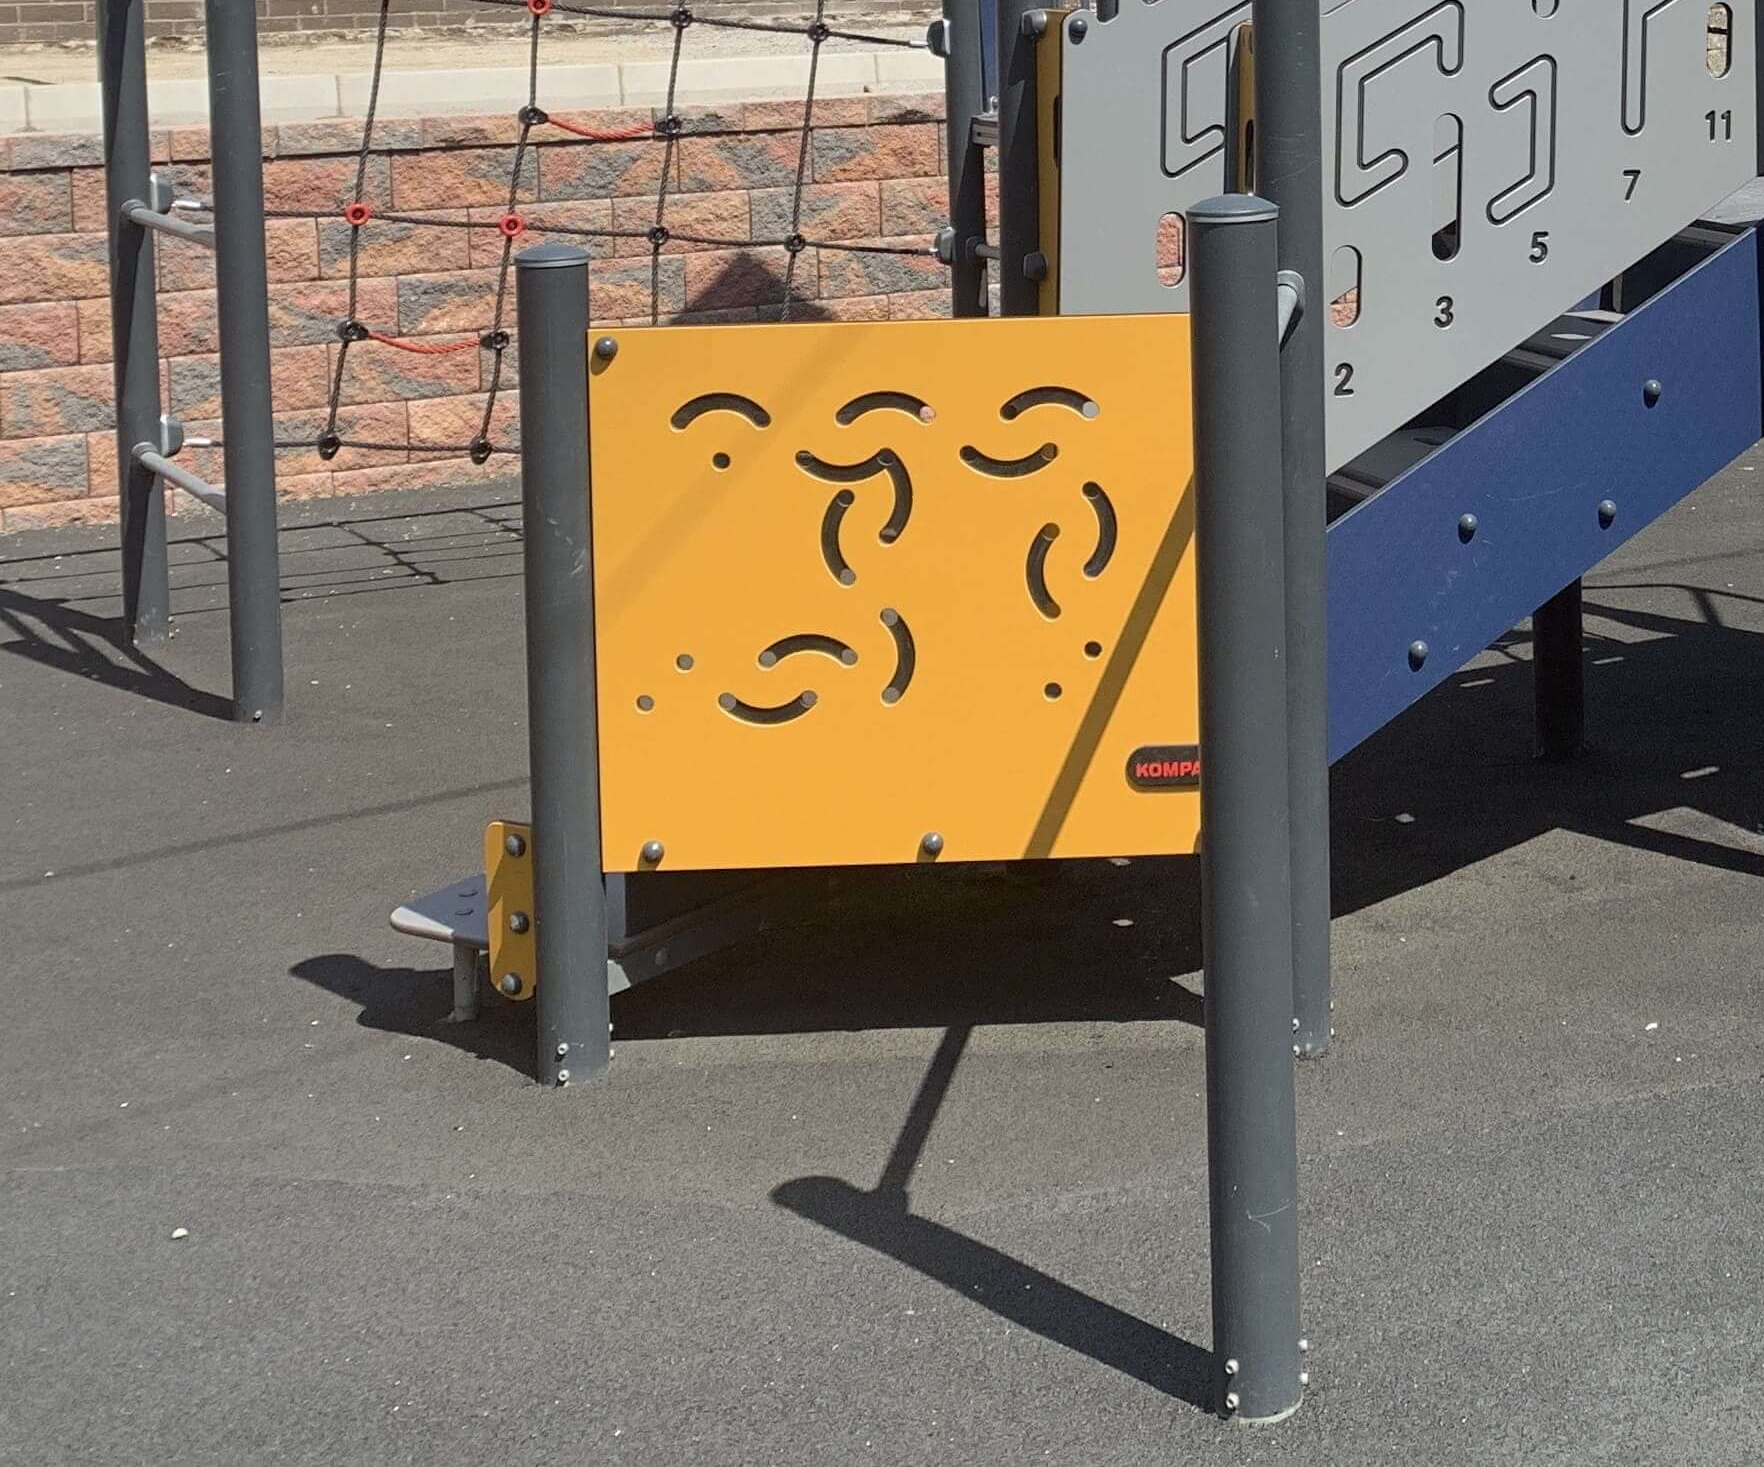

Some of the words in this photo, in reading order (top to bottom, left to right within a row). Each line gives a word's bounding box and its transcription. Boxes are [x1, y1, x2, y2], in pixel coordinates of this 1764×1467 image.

[1704, 109, 1732, 141] 11
[1622, 169, 1642, 201] 7
[1528, 230, 1549, 264] 5
[1433, 295, 1454, 328] 3
[1333, 362, 1355, 396] 2
[1135, 761, 1201, 778] KOMPA
